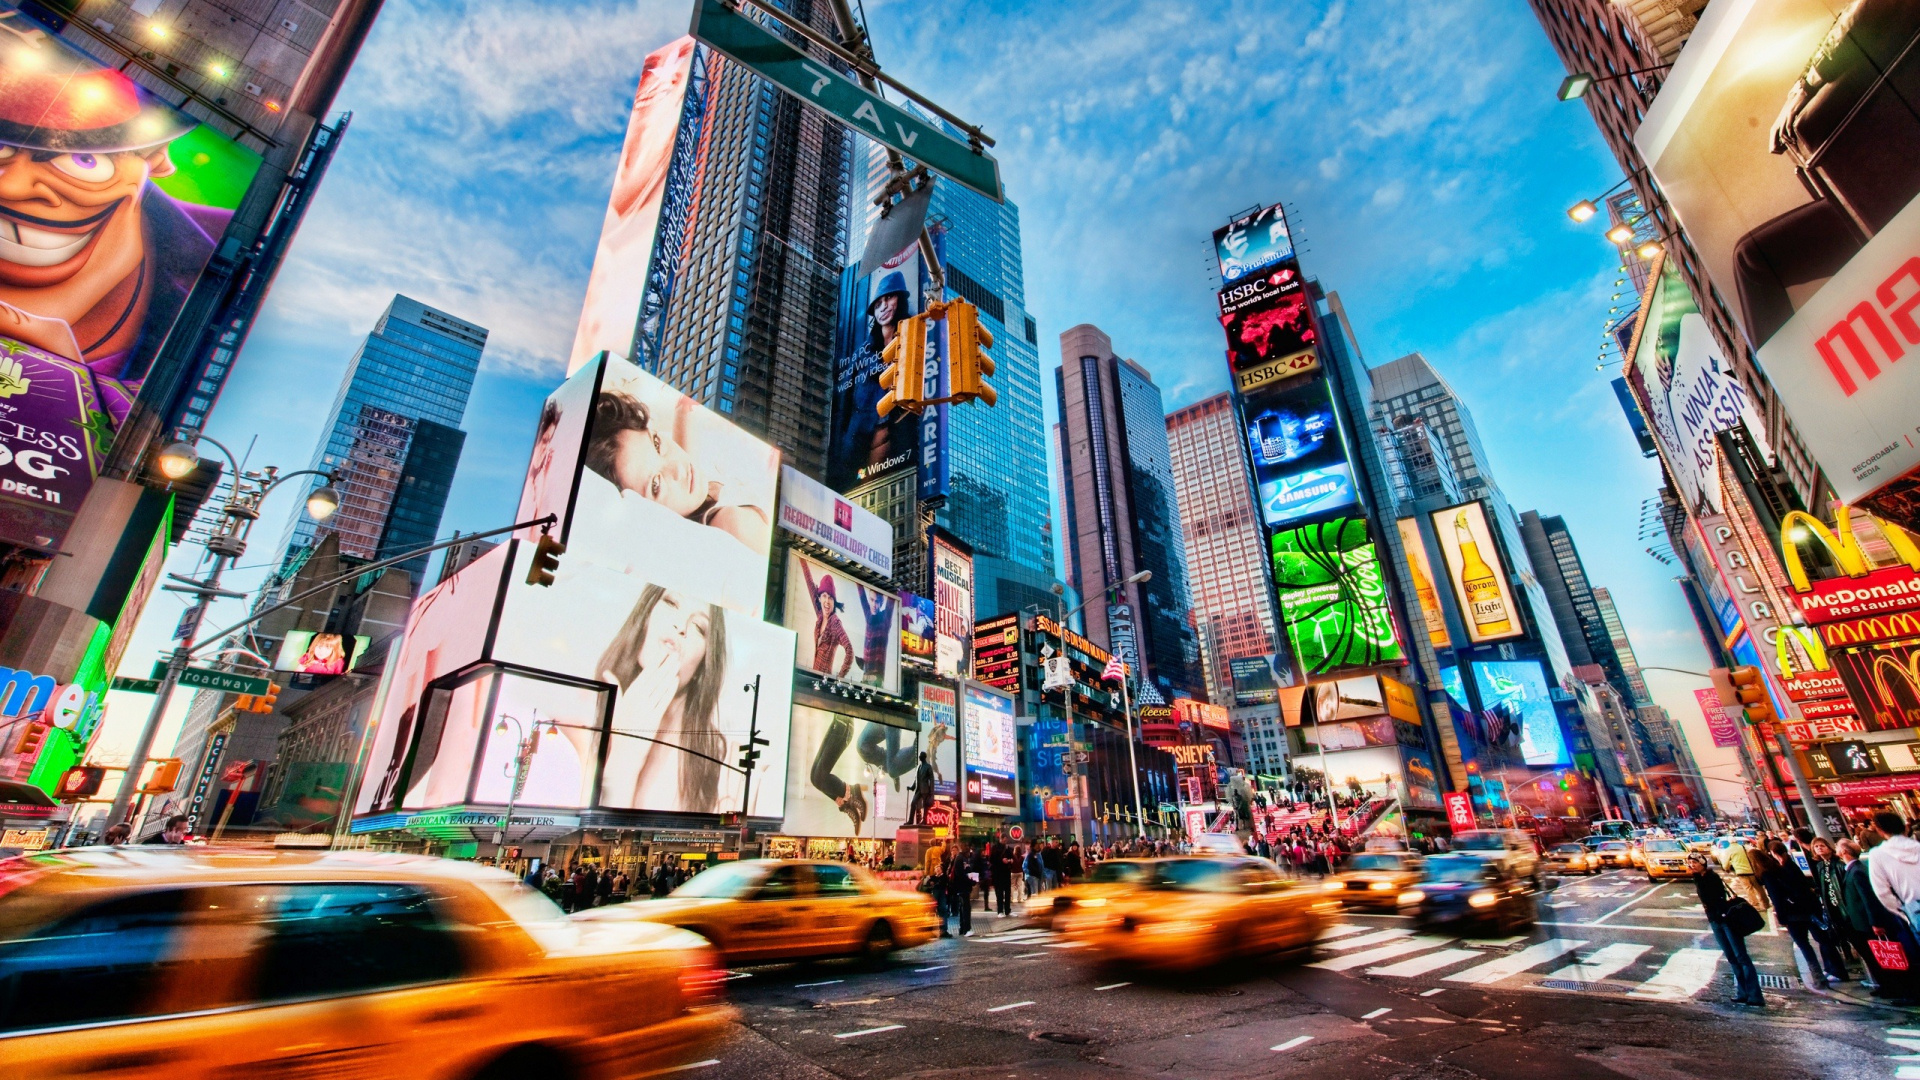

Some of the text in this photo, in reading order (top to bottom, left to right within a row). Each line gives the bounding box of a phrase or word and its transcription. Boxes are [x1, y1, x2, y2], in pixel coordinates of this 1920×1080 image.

[801, 62, 918, 148] 7 AV
[1241, 247, 1292, 272] Prudential
[1221, 278, 1266, 306] HSBC
[1222, 304, 1236, 314] The
[1262, 288, 1280, 299] local
[1280, 281, 1300, 294] bank
[855, 350, 884, 371] Windo
[1240, 361, 1288, 388] HSBC
[1681, 366, 1719, 437] NINJA
[867, 449, 912, 476] Windows 7
[1851, 441, 1900, 474] RECORDABLE
[923, 477, 937, 487] NYC
[1856, 465, 1881, 481] MEDIA
[2, 479, 60, 504] DEC. 11
[1278, 481, 1337, 505] SAMSUNG
[784, 505, 890, 571] READY FOR HOLIDAY CHEER
[937, 564, 970, 592] MUSICAL
[944, 558, 963, 577] BEST
[937, 579, 960, 614] BILLY
[1281, 583, 1340, 601] display powered
[1465, 580, 1498, 593] Corona
[1284, 592, 1339, 608] by wind energy
[1474, 600, 1502, 615] Light
[178, 673, 252, 692] roadway
[923, 687, 955, 706] HEIGHTS
[921, 708, 933, 723] BEST
[1140, 706, 1171, 717] Reese's
[1804, 705, 1831, 714] OPEN
[968, 780, 980, 794] CNN
[407, 815, 447, 826] AMERICAN
[450, 815, 484, 825] EAGLE
[1450, 795, 1467, 825] tkts
